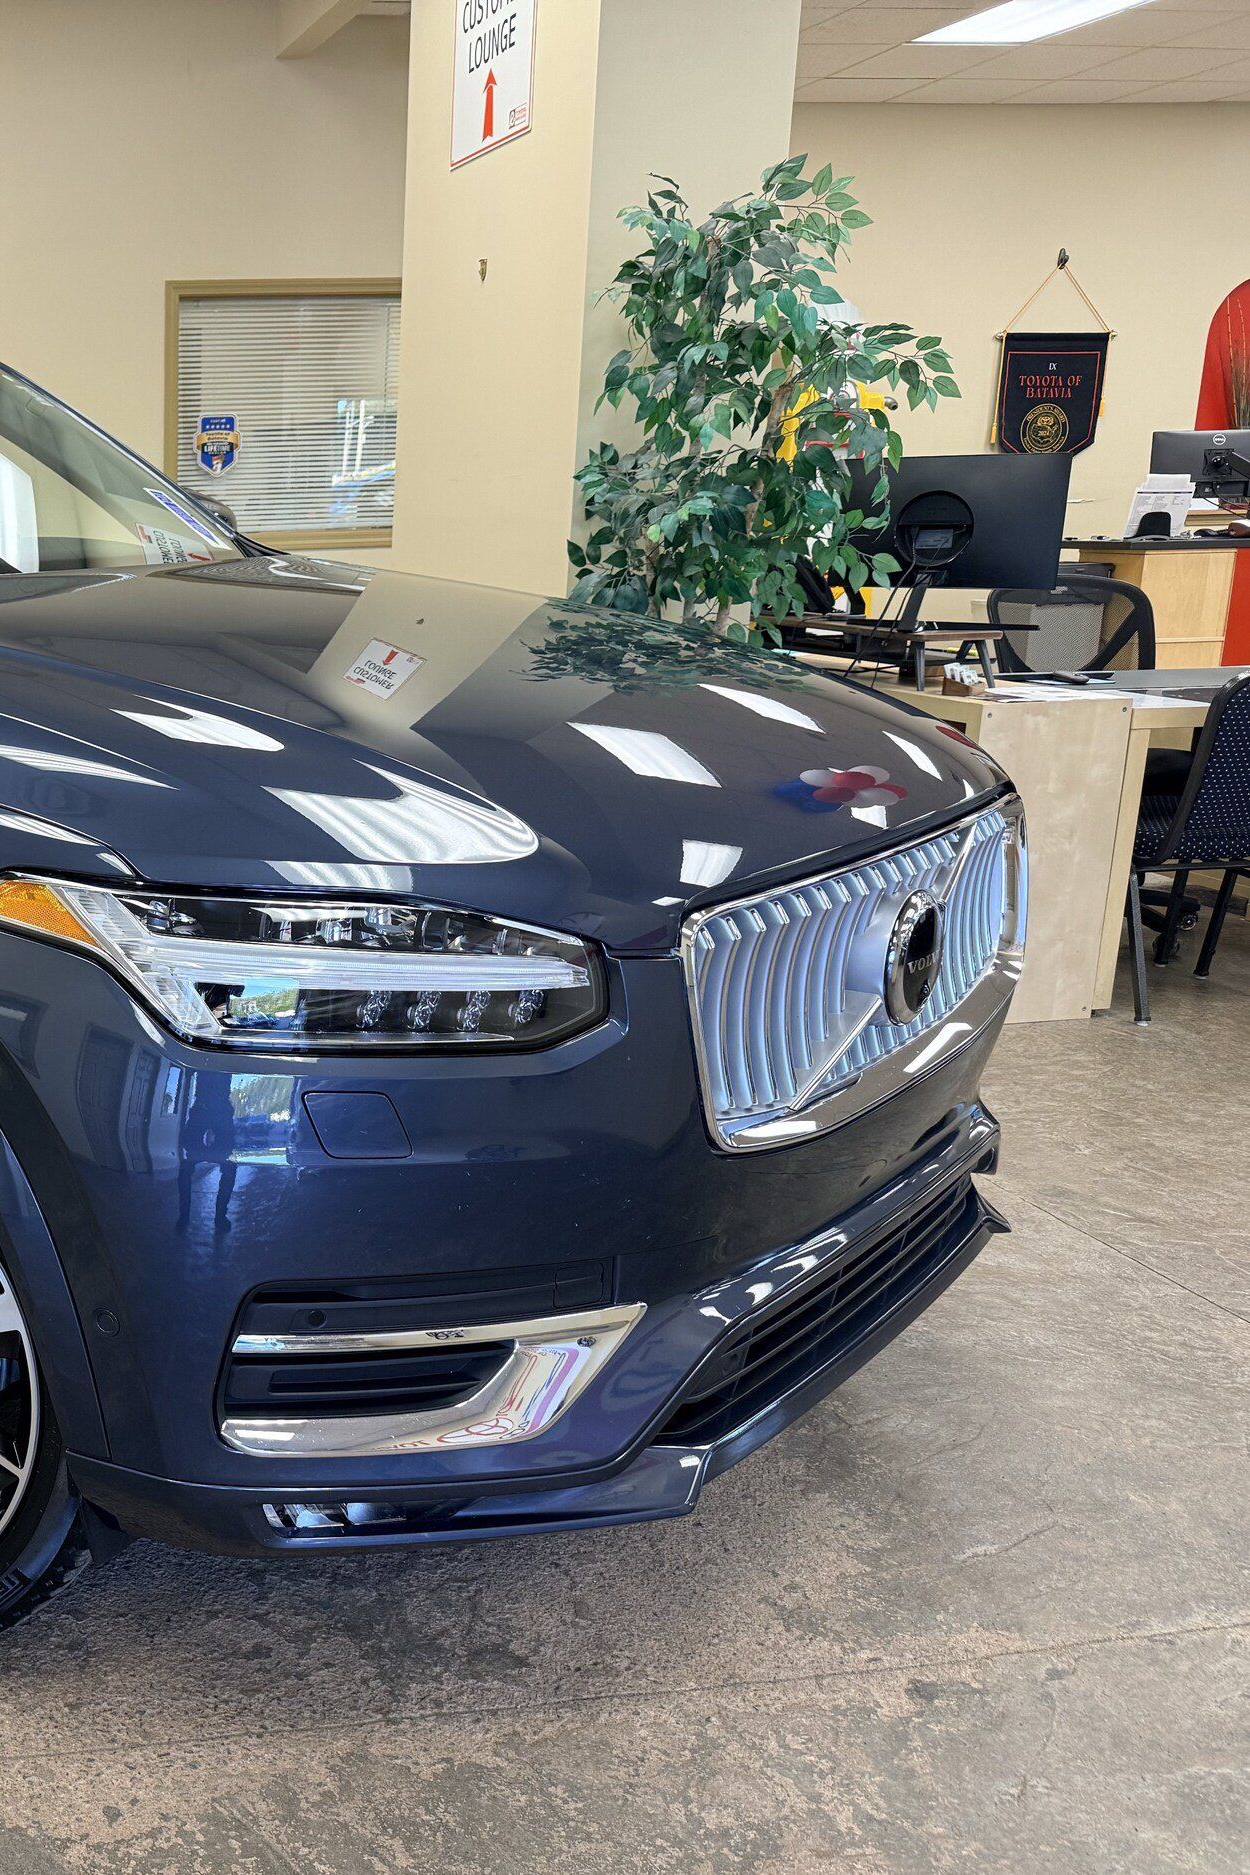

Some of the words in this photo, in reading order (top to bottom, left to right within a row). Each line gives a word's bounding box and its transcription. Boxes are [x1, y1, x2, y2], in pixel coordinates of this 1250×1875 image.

[462, 0, 513, 33] CUSTO
[468, 13, 517, 73] LOUNGE
[1019, 375, 1063, 387] TOYOTA
[1067, 375, 1083, 387] OF
[1026, 387, 1072, 398] BATAVIA
